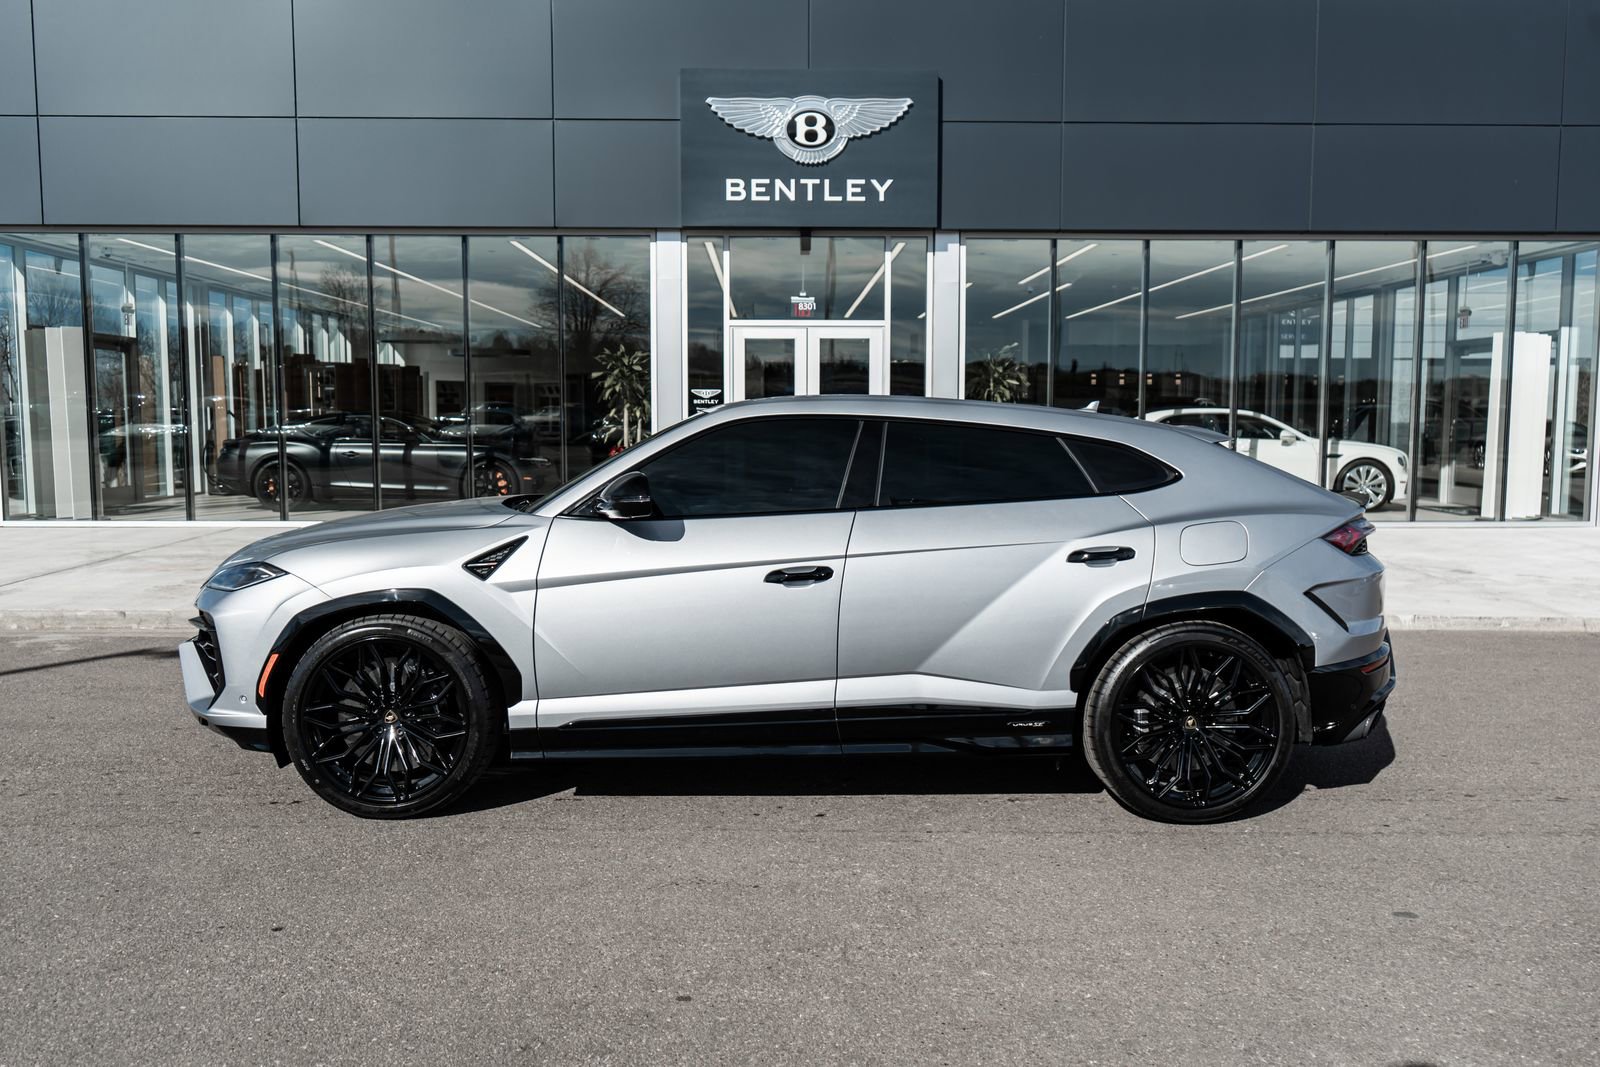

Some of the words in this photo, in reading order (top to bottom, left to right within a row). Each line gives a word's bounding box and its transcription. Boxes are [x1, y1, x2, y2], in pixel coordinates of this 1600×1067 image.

[793, 112, 828, 147] B
[725, 178, 895, 202] BENTLEY
[798, 302, 817, 311] 8301
